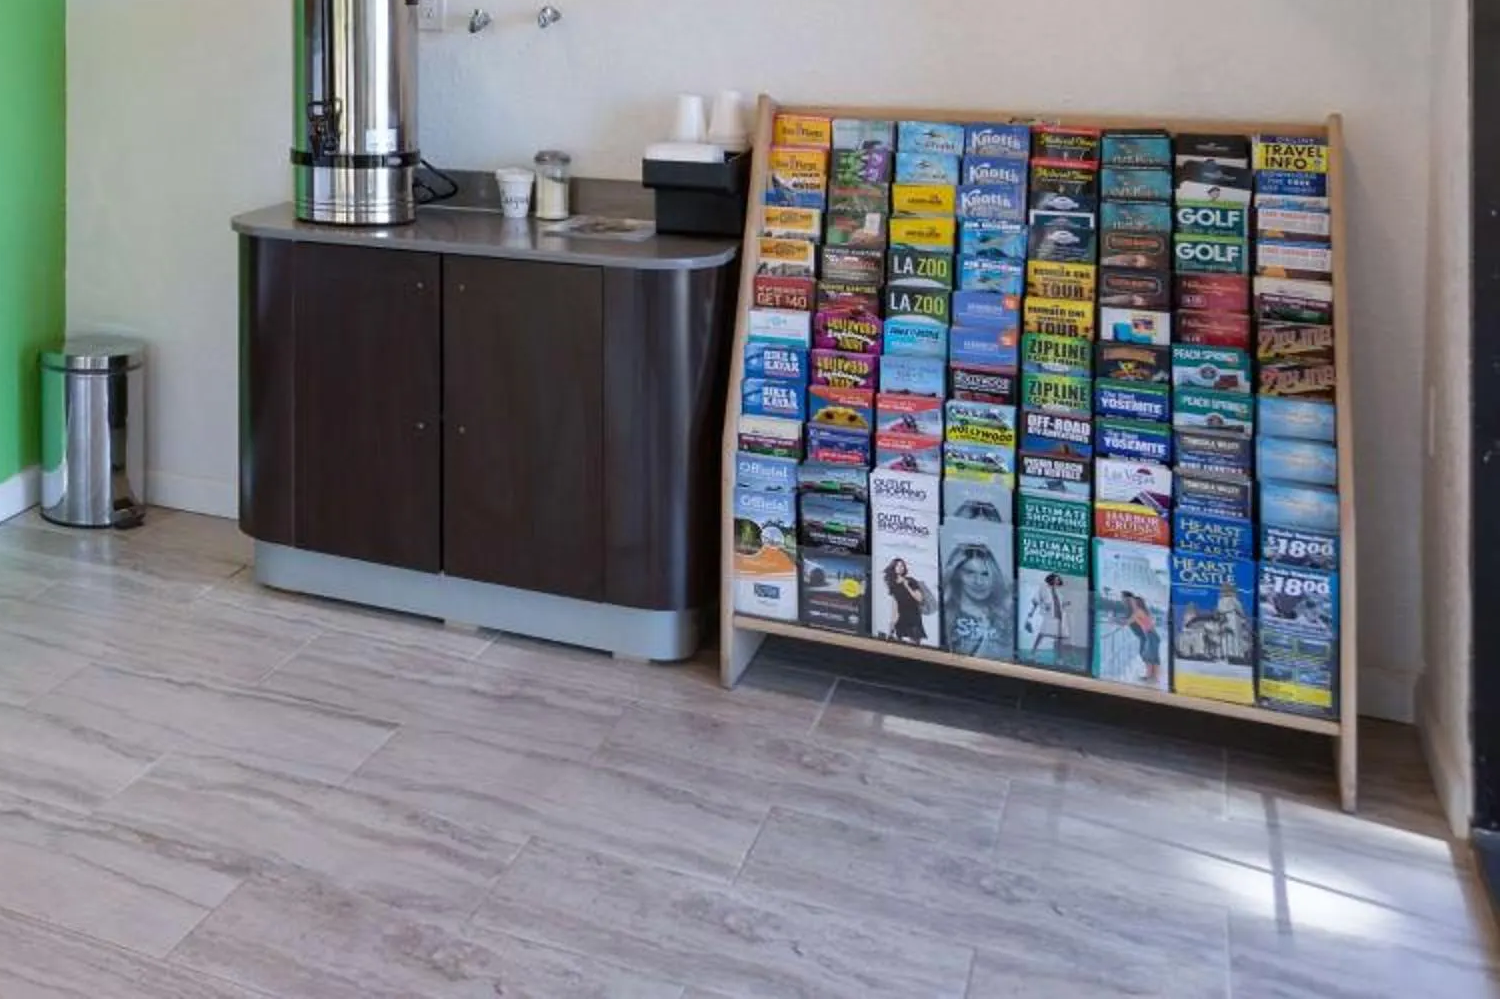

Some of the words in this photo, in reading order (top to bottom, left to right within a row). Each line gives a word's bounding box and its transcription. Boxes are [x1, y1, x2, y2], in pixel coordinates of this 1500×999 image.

[1265, 144, 1323, 158] TRAVEL
[1265, 157, 1307, 169] INFO
[1177, 208, 1240, 227] GOLF
[1175, 242, 1239, 262] GOLF
[893, 254, 914, 275] LA
[917, 258, 947, 278] ZOO
[890, 291, 911, 312] LA
[914, 294, 944, 315] ZOO
[1028, 339, 1087, 358] ZIPLINE
[1028, 379, 1087, 399] ZIPLINE
[1101, 398, 1163, 414] YOSEMITE
[1027, 413, 1090, 434] OFF-ROAD
[949, 424, 1013, 442] HOLLYWOOD
[1104, 436, 1167, 455] YOSEMITE
[874, 486, 927, 500] SHOPPING
[877, 512, 916, 525] OUTLET
[1025, 504, 1087, 520] ULTIMATE
[1025, 512, 1088, 529] SHOPPING
[877, 520, 929, 537] SHOPPING
[1180, 517, 1241, 537] HEARST
[1023, 538, 1085, 554] ULTIMATE
[1185, 530, 1238, 547] CASTLE
[1024, 547, 1085, 564] SHOPPING
[1173, 556, 1235, 574] HEARST
[1179, 569, 1236, 585] CASTLE
